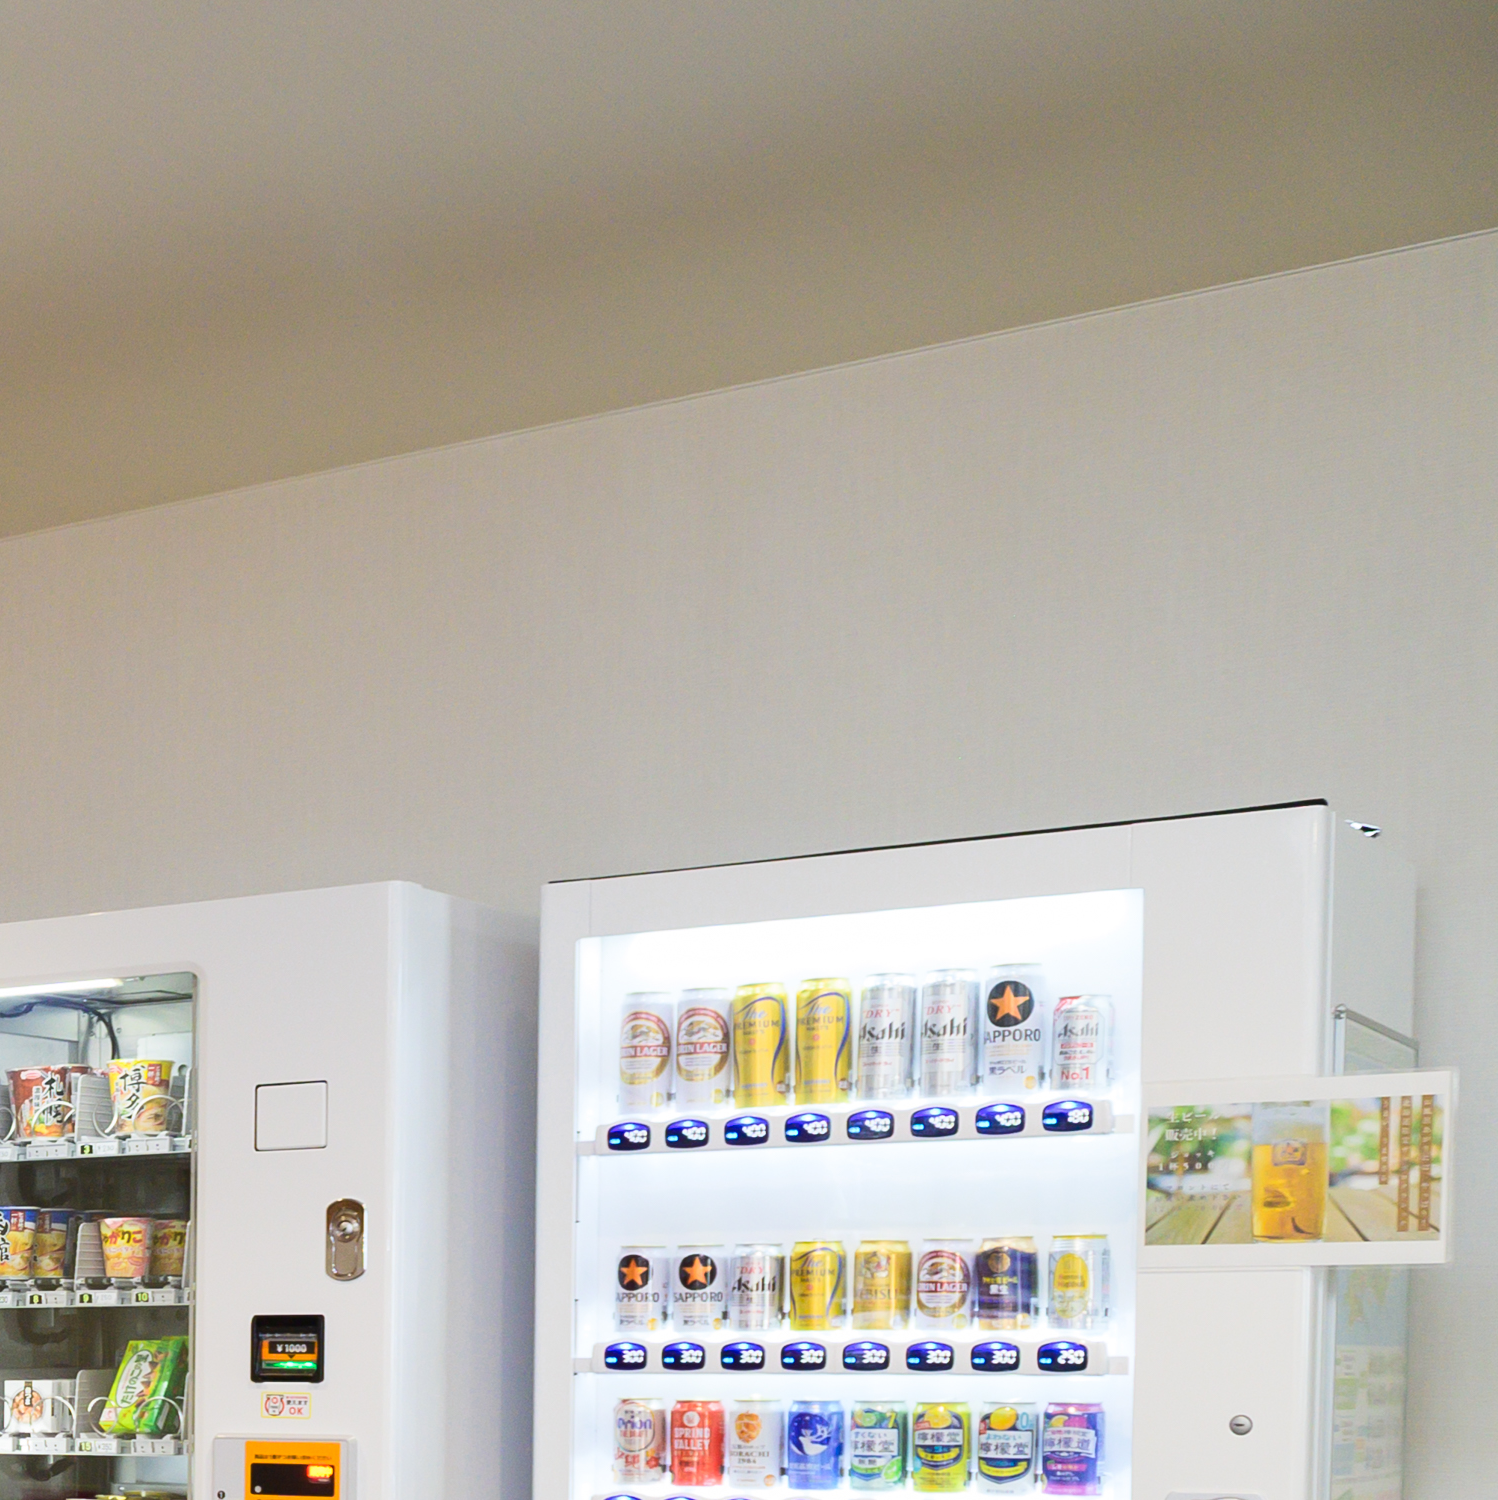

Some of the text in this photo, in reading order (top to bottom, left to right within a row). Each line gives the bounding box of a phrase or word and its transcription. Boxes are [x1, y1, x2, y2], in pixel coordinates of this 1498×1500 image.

[859, 1020, 905, 1040] Asahi
[921, 1017, 968, 1039] Asahi
[1057, 1022, 1099, 1039] Asahi
[636, 1045, 668, 1057] LAGER
[696, 1042, 727, 1054] LAGER
[989, 1065, 1026, 1075] 黒ラベル
[1061, 1067, 1090, 1082] No.1
[119, 1065, 146, 1119] 博多
[41, 1075, 65, 1125] 札幌
[865, 1117, 890, 1131] 400
[929, 1115, 955, 1129] 400
[995, 1112, 1021, 1126] 400
[1167, 1111, 1219, 1124] 生ビール
[682, 1127, 706, 1140] 400
[742, 1124, 766, 1137] 400
[803, 1120, 827, 1134] 400
[624, 1129, 647, 1142] 400
[1164, 1128, 1218, 1141] 販売中！
[83, 1145, 90, 1154] 3
[1170, 1149, 1216, 1160] ジョッキ
[732, 1275, 776, 1293] Asahi
[936, 1282, 967, 1293] LAGER
[32, 1295, 39, 1303] 8
[82, 1294, 89, 1303] 9
[137, 1292, 148, 1302] 10
[276, 1344, 307, 1353] ¥1000
[623, 1350, 644, 1363] 300
[680, 1350, 703, 1363] 300
[740, 1350, 763, 1363] 300
[800, 1350, 824, 1363] 300
[862, 1350, 886, 1363] 300
[926, 1350, 951, 1363] 300
[992, 1350, 1016, 1363] 300
[1057, 1350, 1084, 1364] 250
[119, 1353, 151, 1407] たけのこの里
[289, 1407, 303, 1415] OK
[617, 1417, 652, 1430] Orion
[674, 1427, 710, 1438] SPRING
[916, 1432, 961, 1444] 檸檬堂
[81, 1441, 91, 1451] 15
[674, 1439, 710, 1450] VALLEY
[979, 1441, 1029, 1456] 檸檬堂
